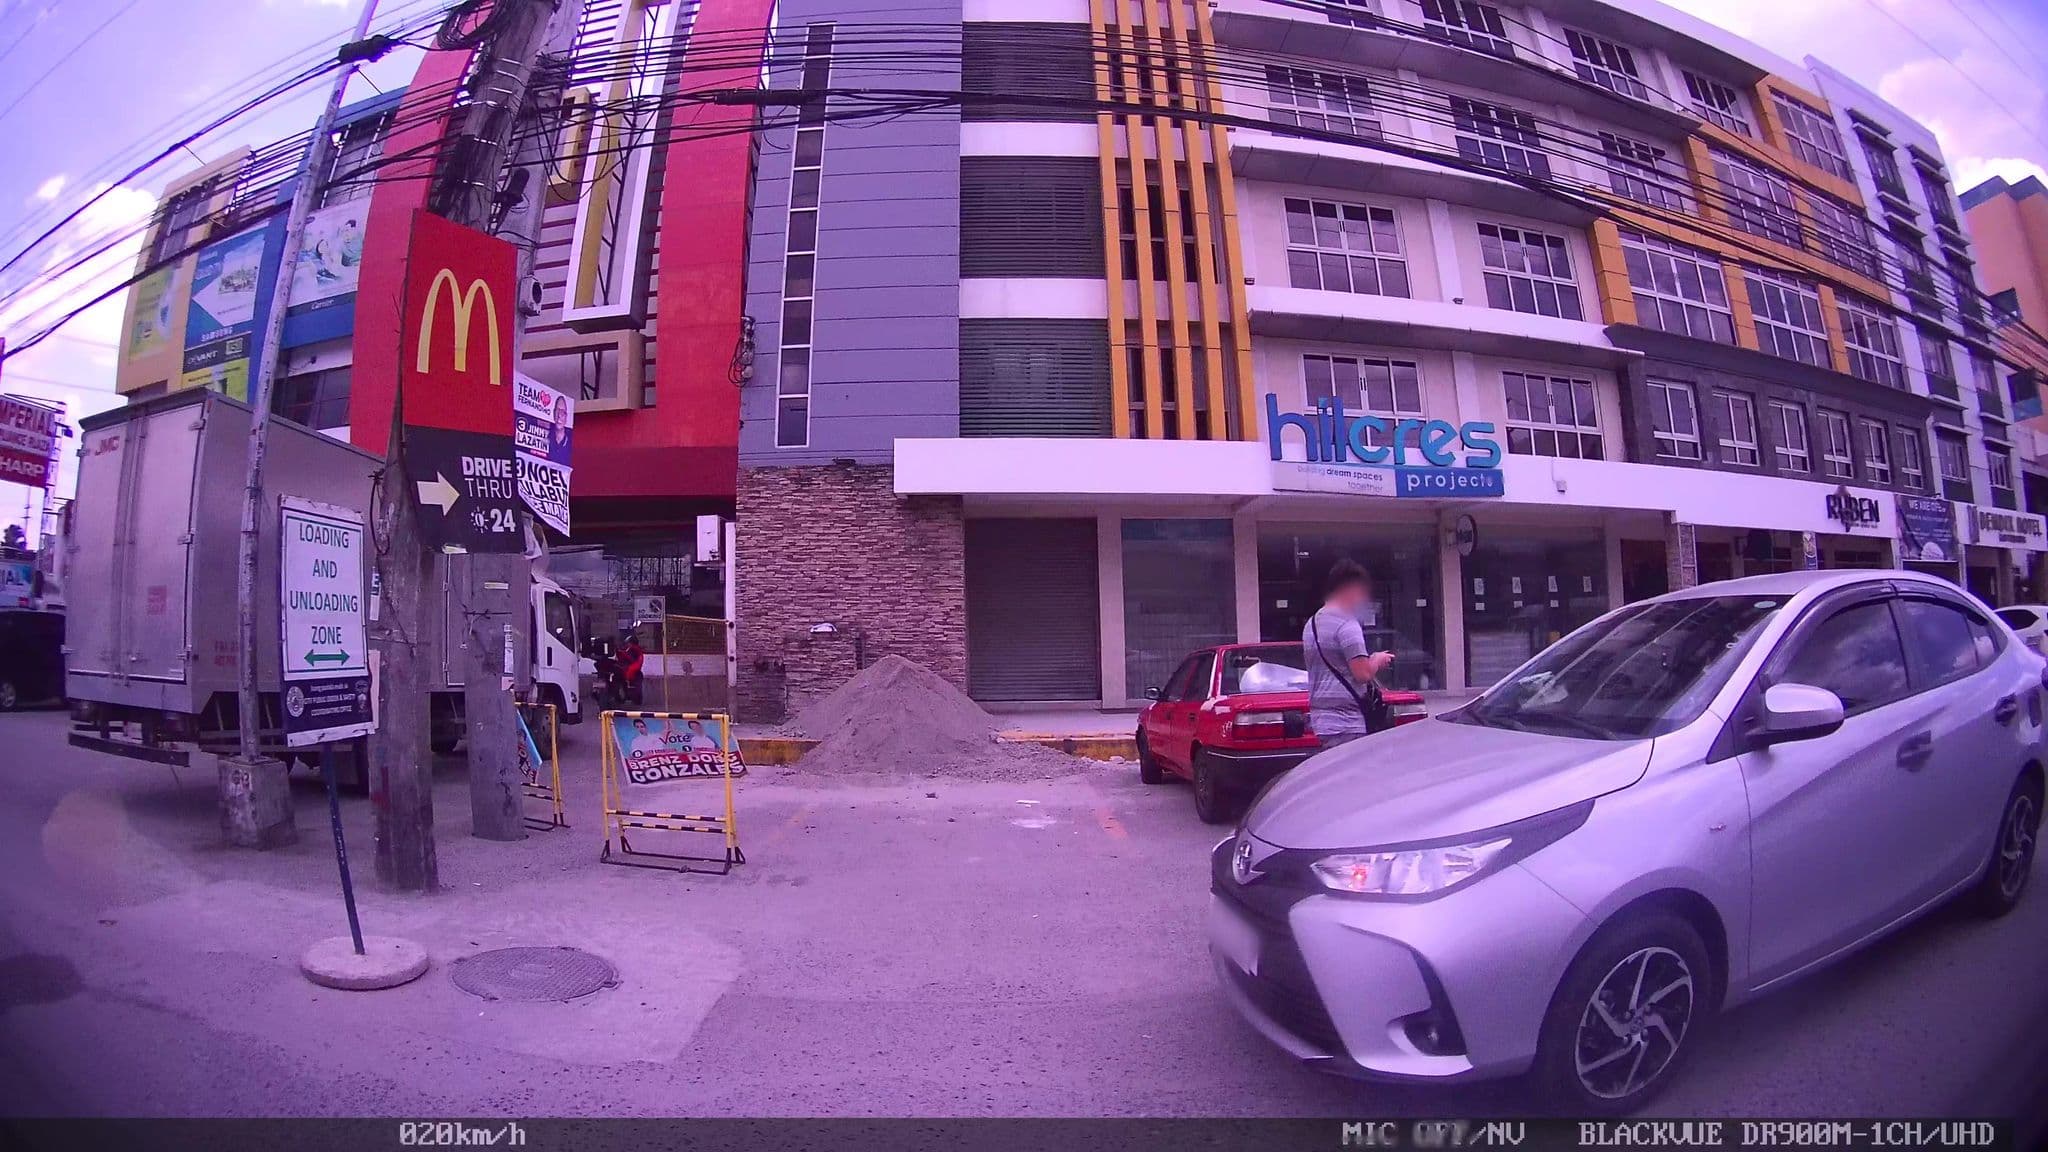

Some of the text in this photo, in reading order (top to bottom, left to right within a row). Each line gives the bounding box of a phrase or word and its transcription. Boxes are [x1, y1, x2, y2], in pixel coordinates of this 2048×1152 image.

[518, 382, 540, 403] TEAM
[1266, 392, 1502, 468] hilcres
[0, 456, 46, 477] HARP
[462, 456, 512, 478] DRIVE
[528, 461, 568, 490] NOEL
[1326, 467, 1352, 478] dream
[1353, 470, 1383, 482] spaces
[464, 478, 513, 499] THRU
[490, 508, 516, 532] 24
[300, 523, 349, 549] LOADING
[312, 558, 338, 579] AND
[289, 590, 359, 613] UNLOADING
[311, 625, 342, 645] ZONE
[658, 731, 696, 745] Vote
[629, 755, 682, 771] BRENZ
[631, 761, 744, 782] GONZALES
